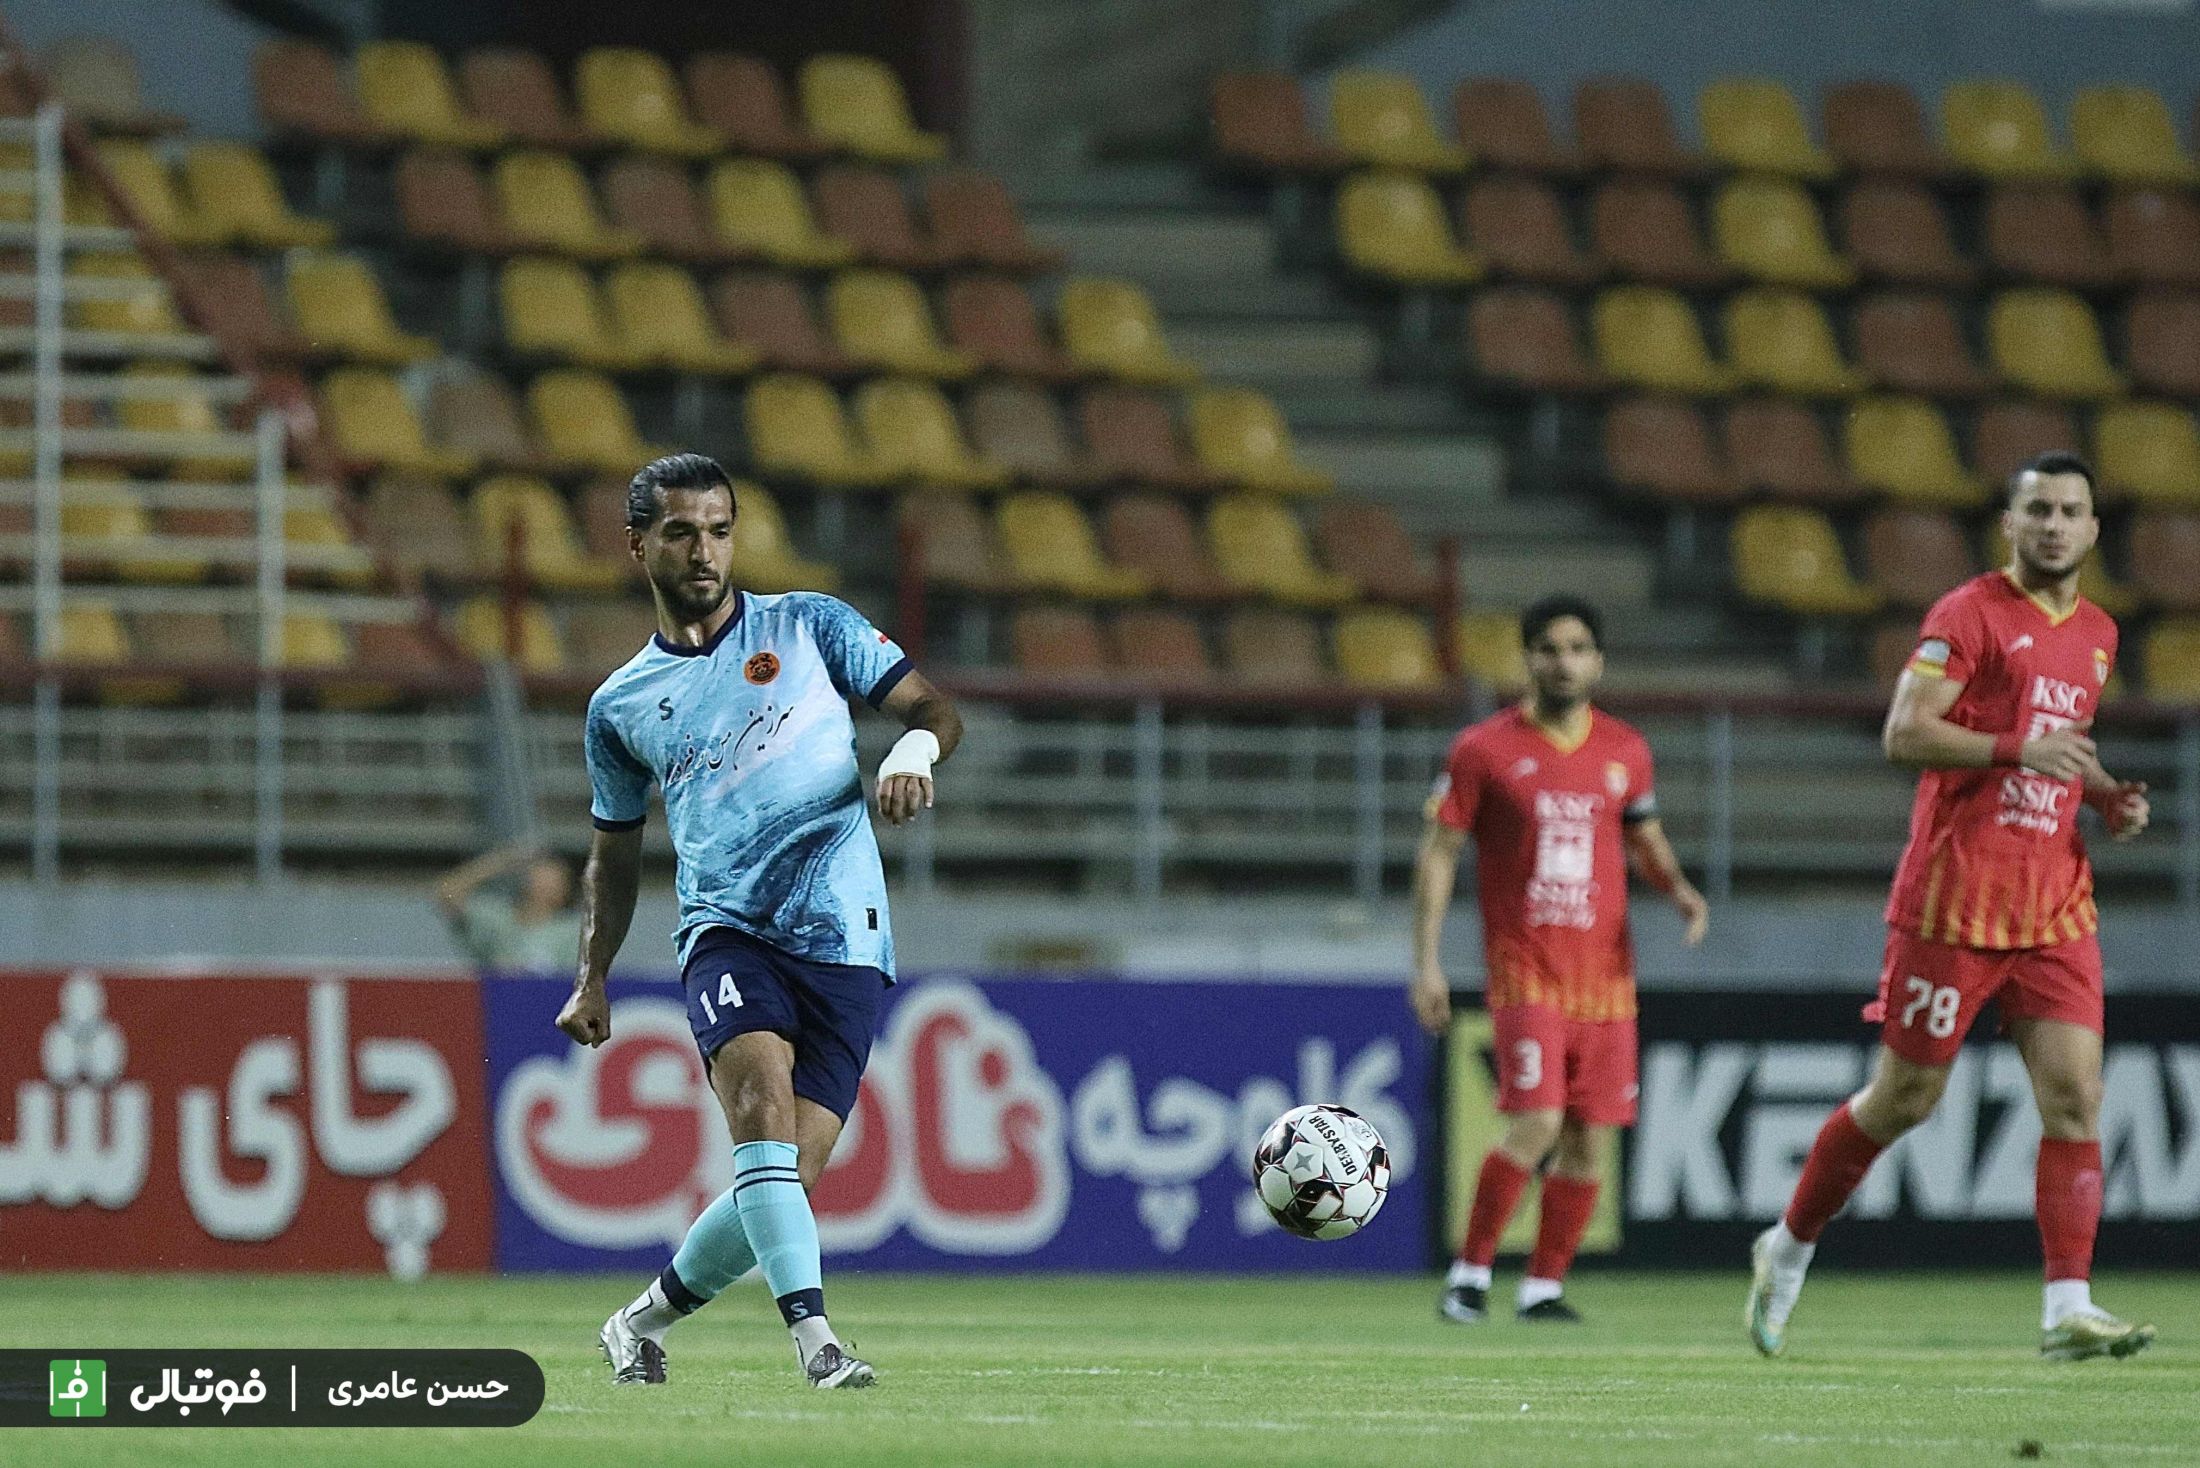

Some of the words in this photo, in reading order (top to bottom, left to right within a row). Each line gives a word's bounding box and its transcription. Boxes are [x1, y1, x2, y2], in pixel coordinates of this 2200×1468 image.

[2032, 675, 2088, 718] KSC
[700, 973, 744, 1025] 14
[1901, 975, 1962, 1039] 78
[1513, 1037, 1543, 1090] 3
[176, 978, 458, 1284] چای
[1308, 1114, 1358, 1177] DERBYSTAR
